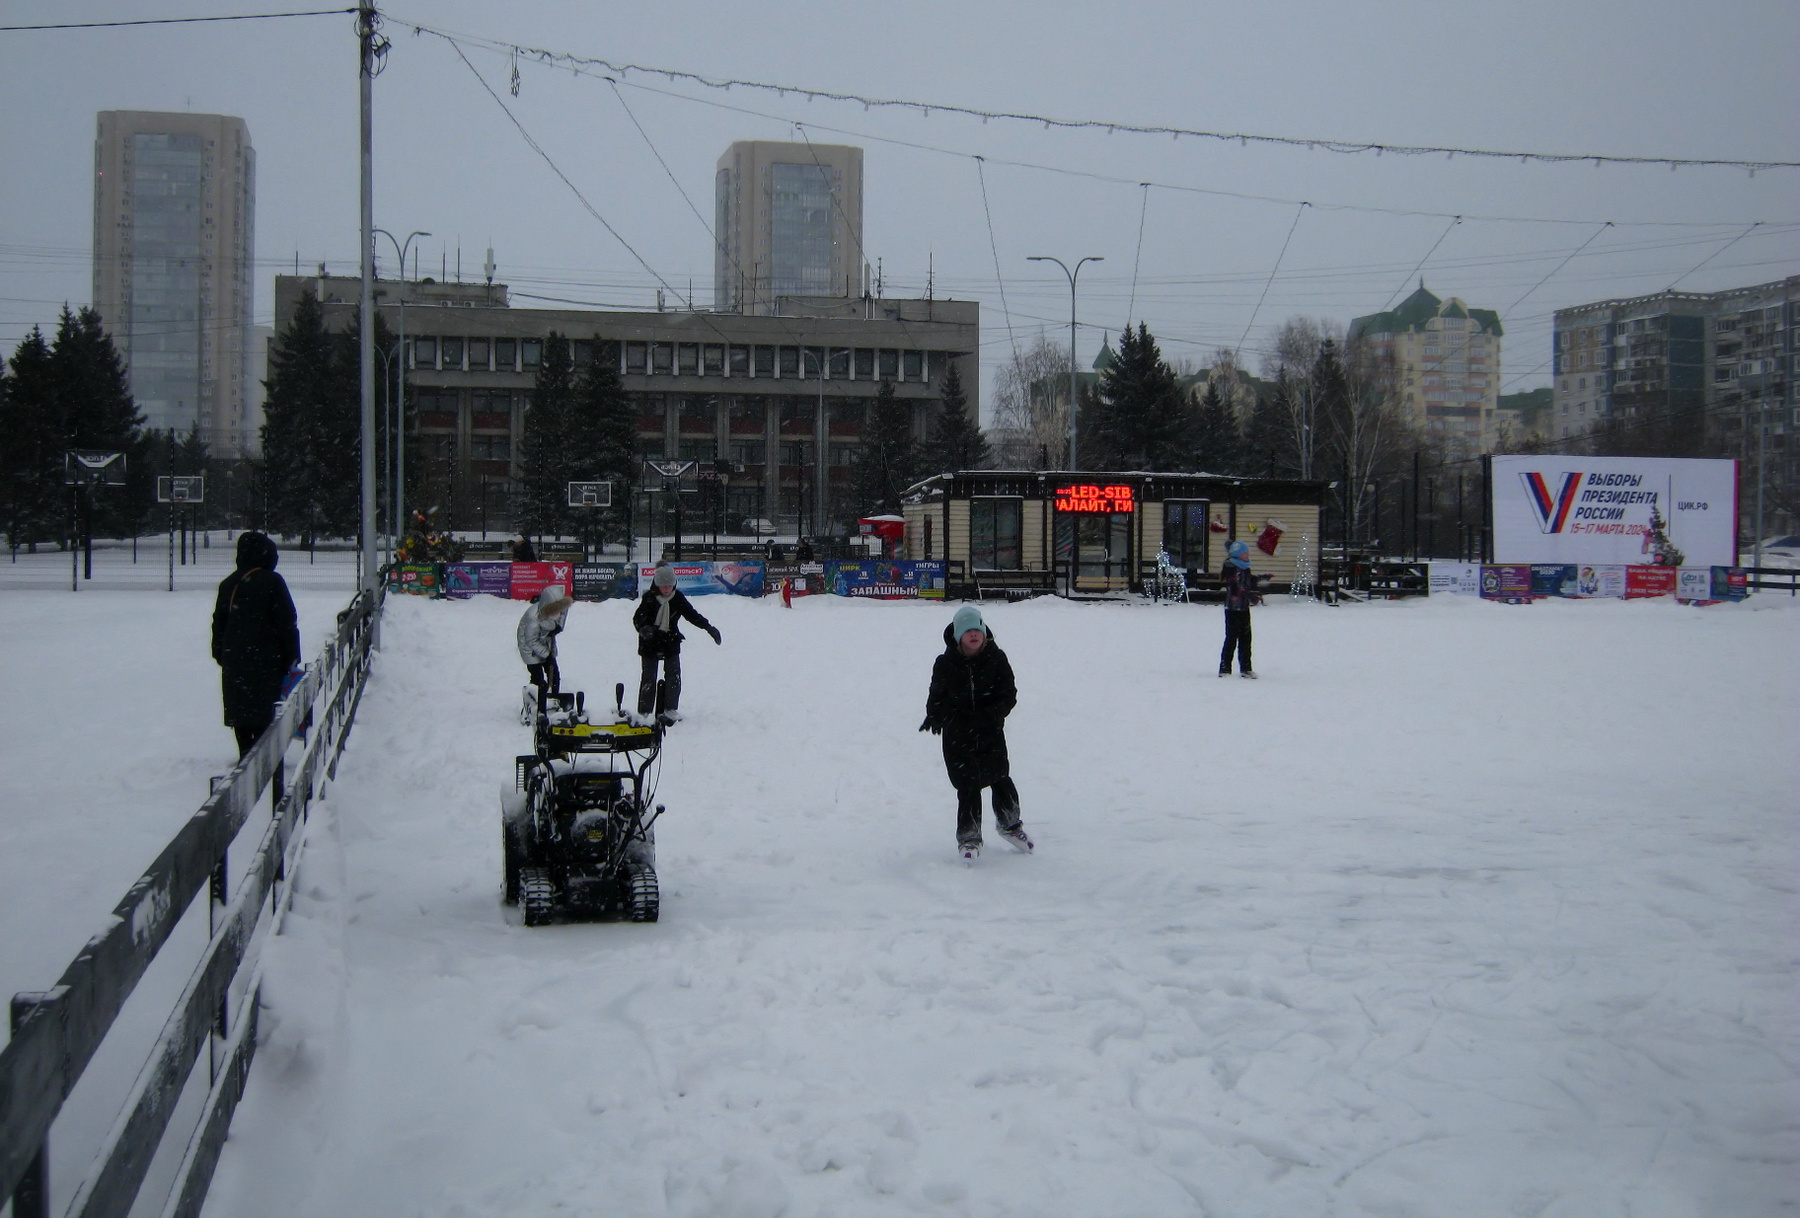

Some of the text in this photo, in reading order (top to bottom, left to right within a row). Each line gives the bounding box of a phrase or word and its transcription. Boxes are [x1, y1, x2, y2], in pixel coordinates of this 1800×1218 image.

[1587, 472, 1643, 487] ВЫБОРЫ
[1071, 485, 1133, 499] LED-SIB
[1580, 490, 1658, 505] ПРЕЗИДЕНТА
[1677, 501, 1709, 511] ЦИК.РФ
[1575, 506, 1625, 520] РОССИИ
[1570, 523, 1594, 534] 15–17
[1595, 524, 1625, 535] МАРТА
[915, 562, 940, 570] ТИГРЫ
[850, 585, 918, 596] ЗАПАШНЫЙ
